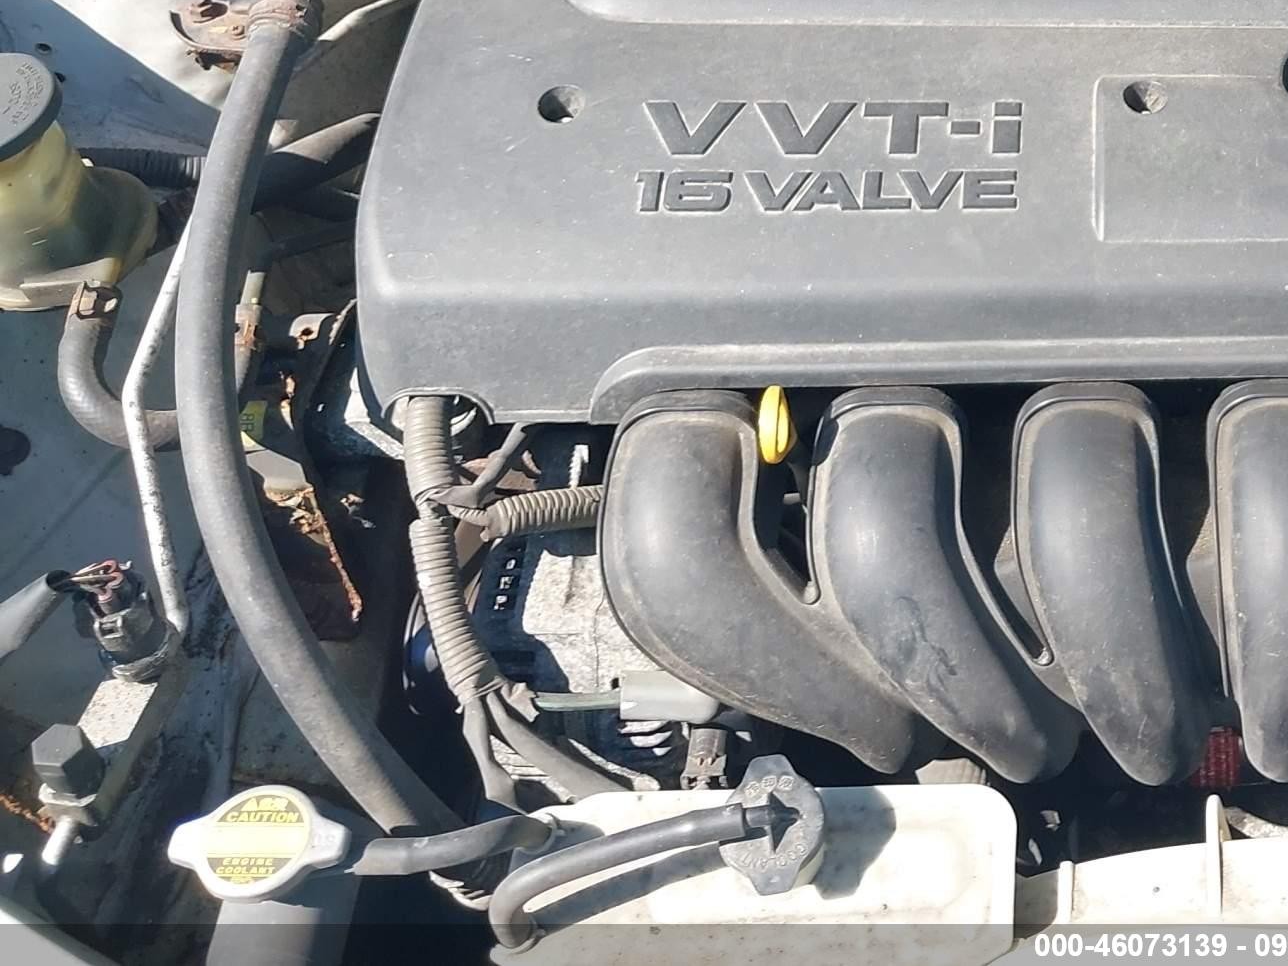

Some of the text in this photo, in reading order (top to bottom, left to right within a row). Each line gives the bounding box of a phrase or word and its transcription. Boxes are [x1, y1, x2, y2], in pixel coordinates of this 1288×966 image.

[643, 100, 1023, 156] VVT-i
[635, 170, 1018, 212] 16 VALVE
[225, 811, 299, 823] CAUTION
[222, 857, 273, 866] ENGINE
[215, 866, 276, 875] COOLANT
